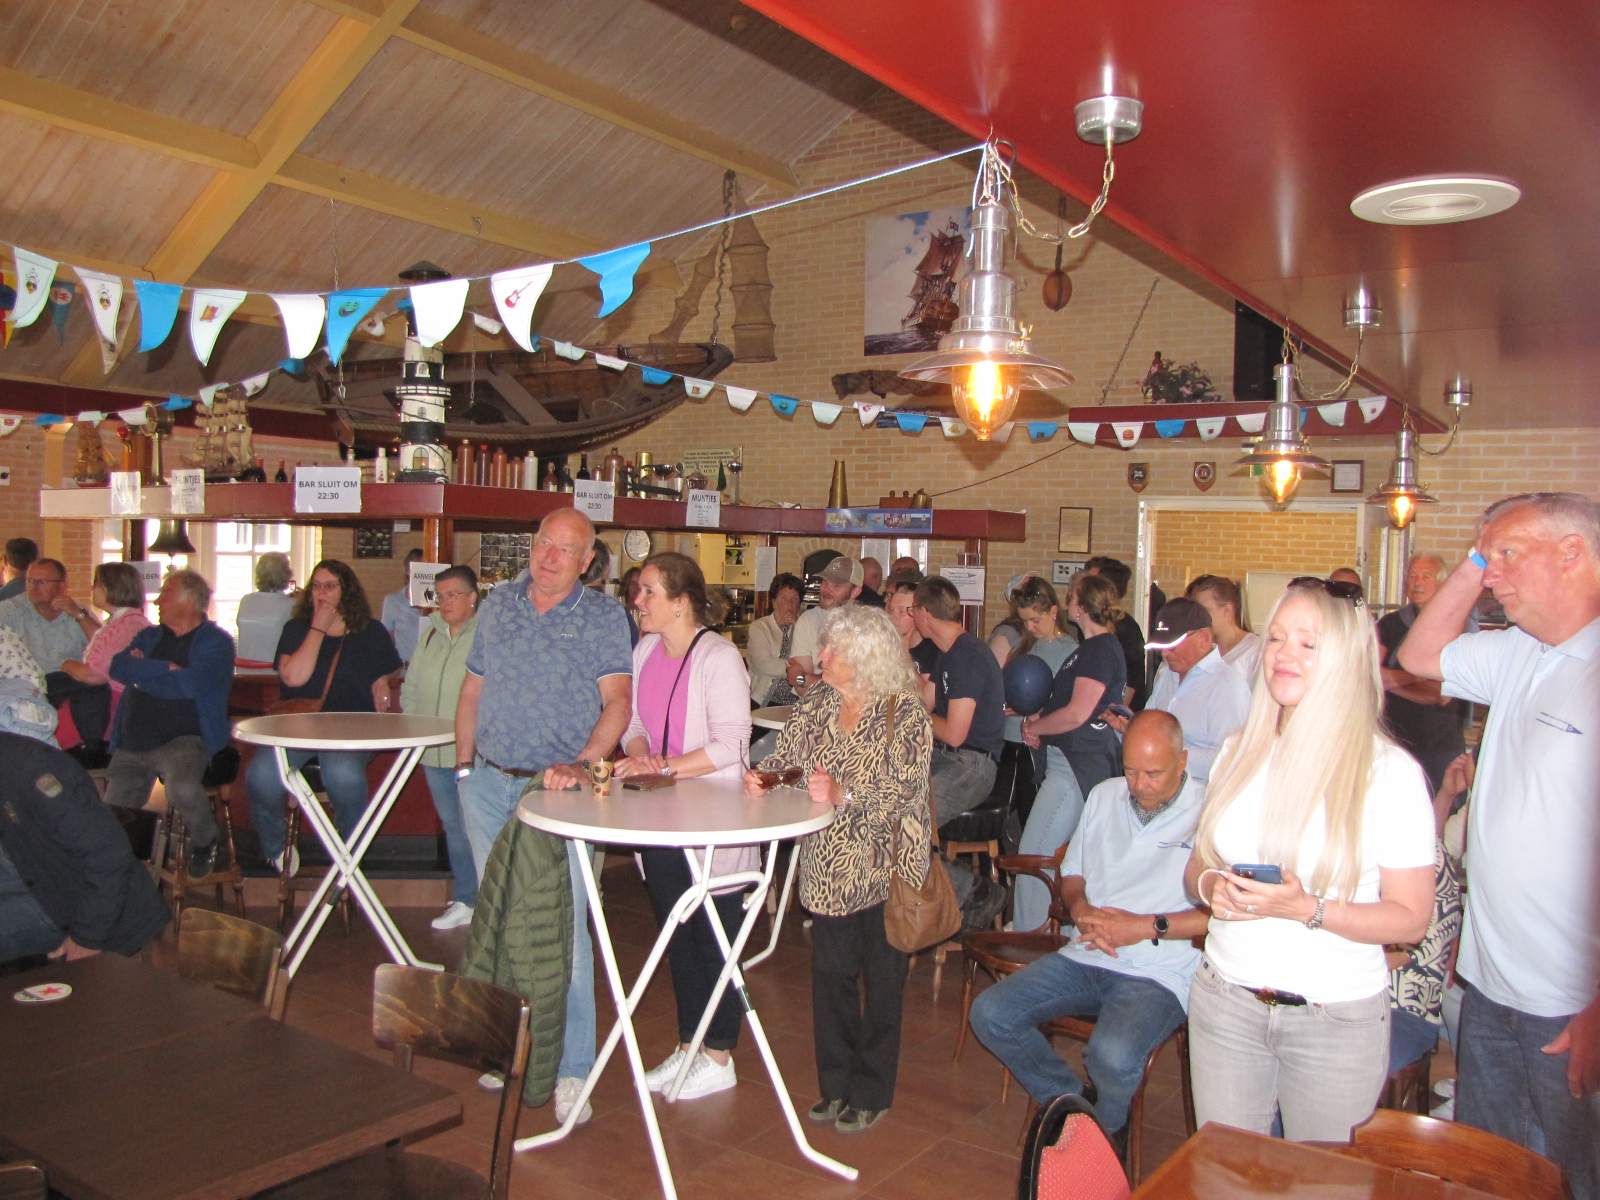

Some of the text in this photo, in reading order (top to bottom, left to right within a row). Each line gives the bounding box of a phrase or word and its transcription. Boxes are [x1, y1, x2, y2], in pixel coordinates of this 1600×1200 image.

[175, 475, 201, 486] UNTJES
[576, 491, 588, 499] BAR
[691, 494, 717, 504] MUNTJES
[587, 502, 602, 510] 22:30
